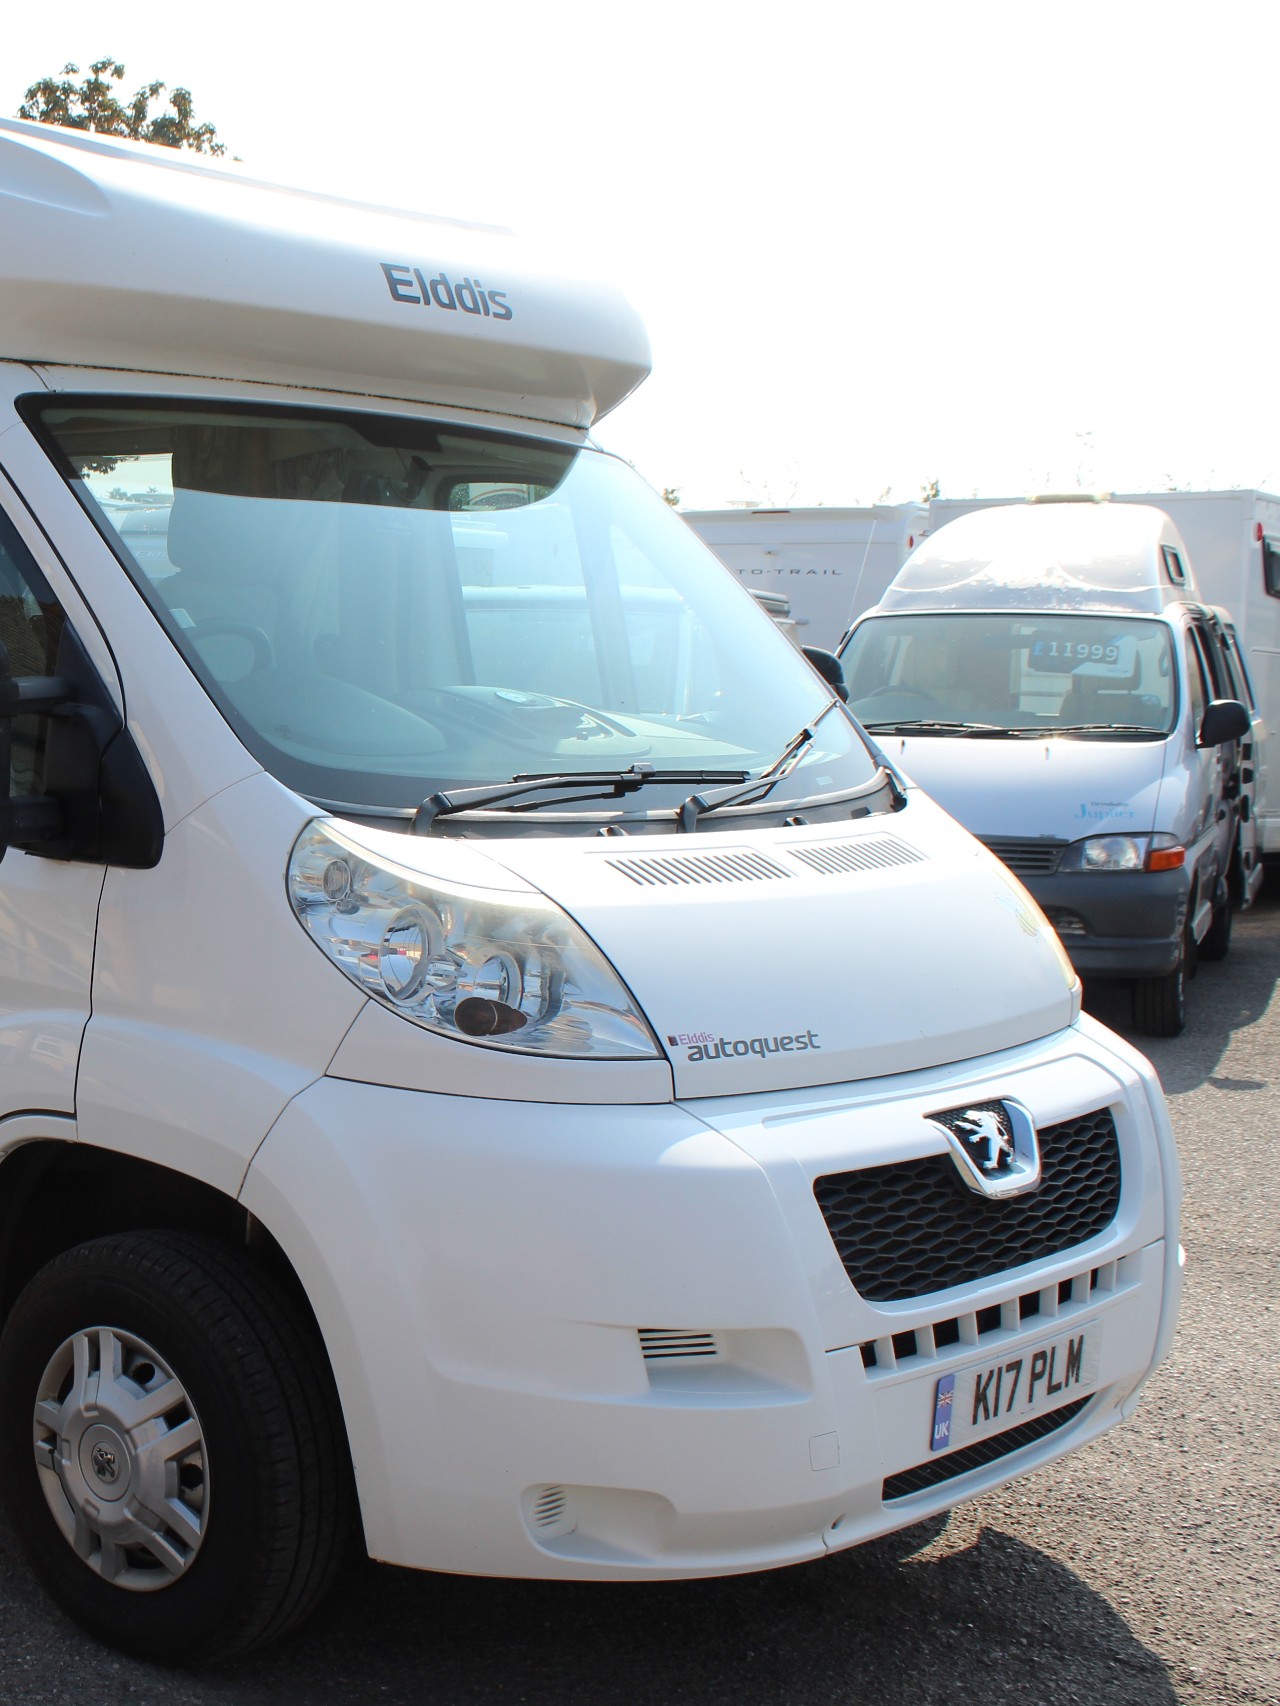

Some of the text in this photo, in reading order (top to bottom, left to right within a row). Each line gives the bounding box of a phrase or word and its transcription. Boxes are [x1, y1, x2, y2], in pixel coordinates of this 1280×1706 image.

[379, 262, 513, 321] Elddis
[1033, 641, 1118, 661] £11999
[677, 1031, 715, 1045] Elddis
[687, 1029, 821, 1062] autoquest
[971, 1334, 1084, 1426] K17 PLM
[934, 1420, 950, 1439] UK
